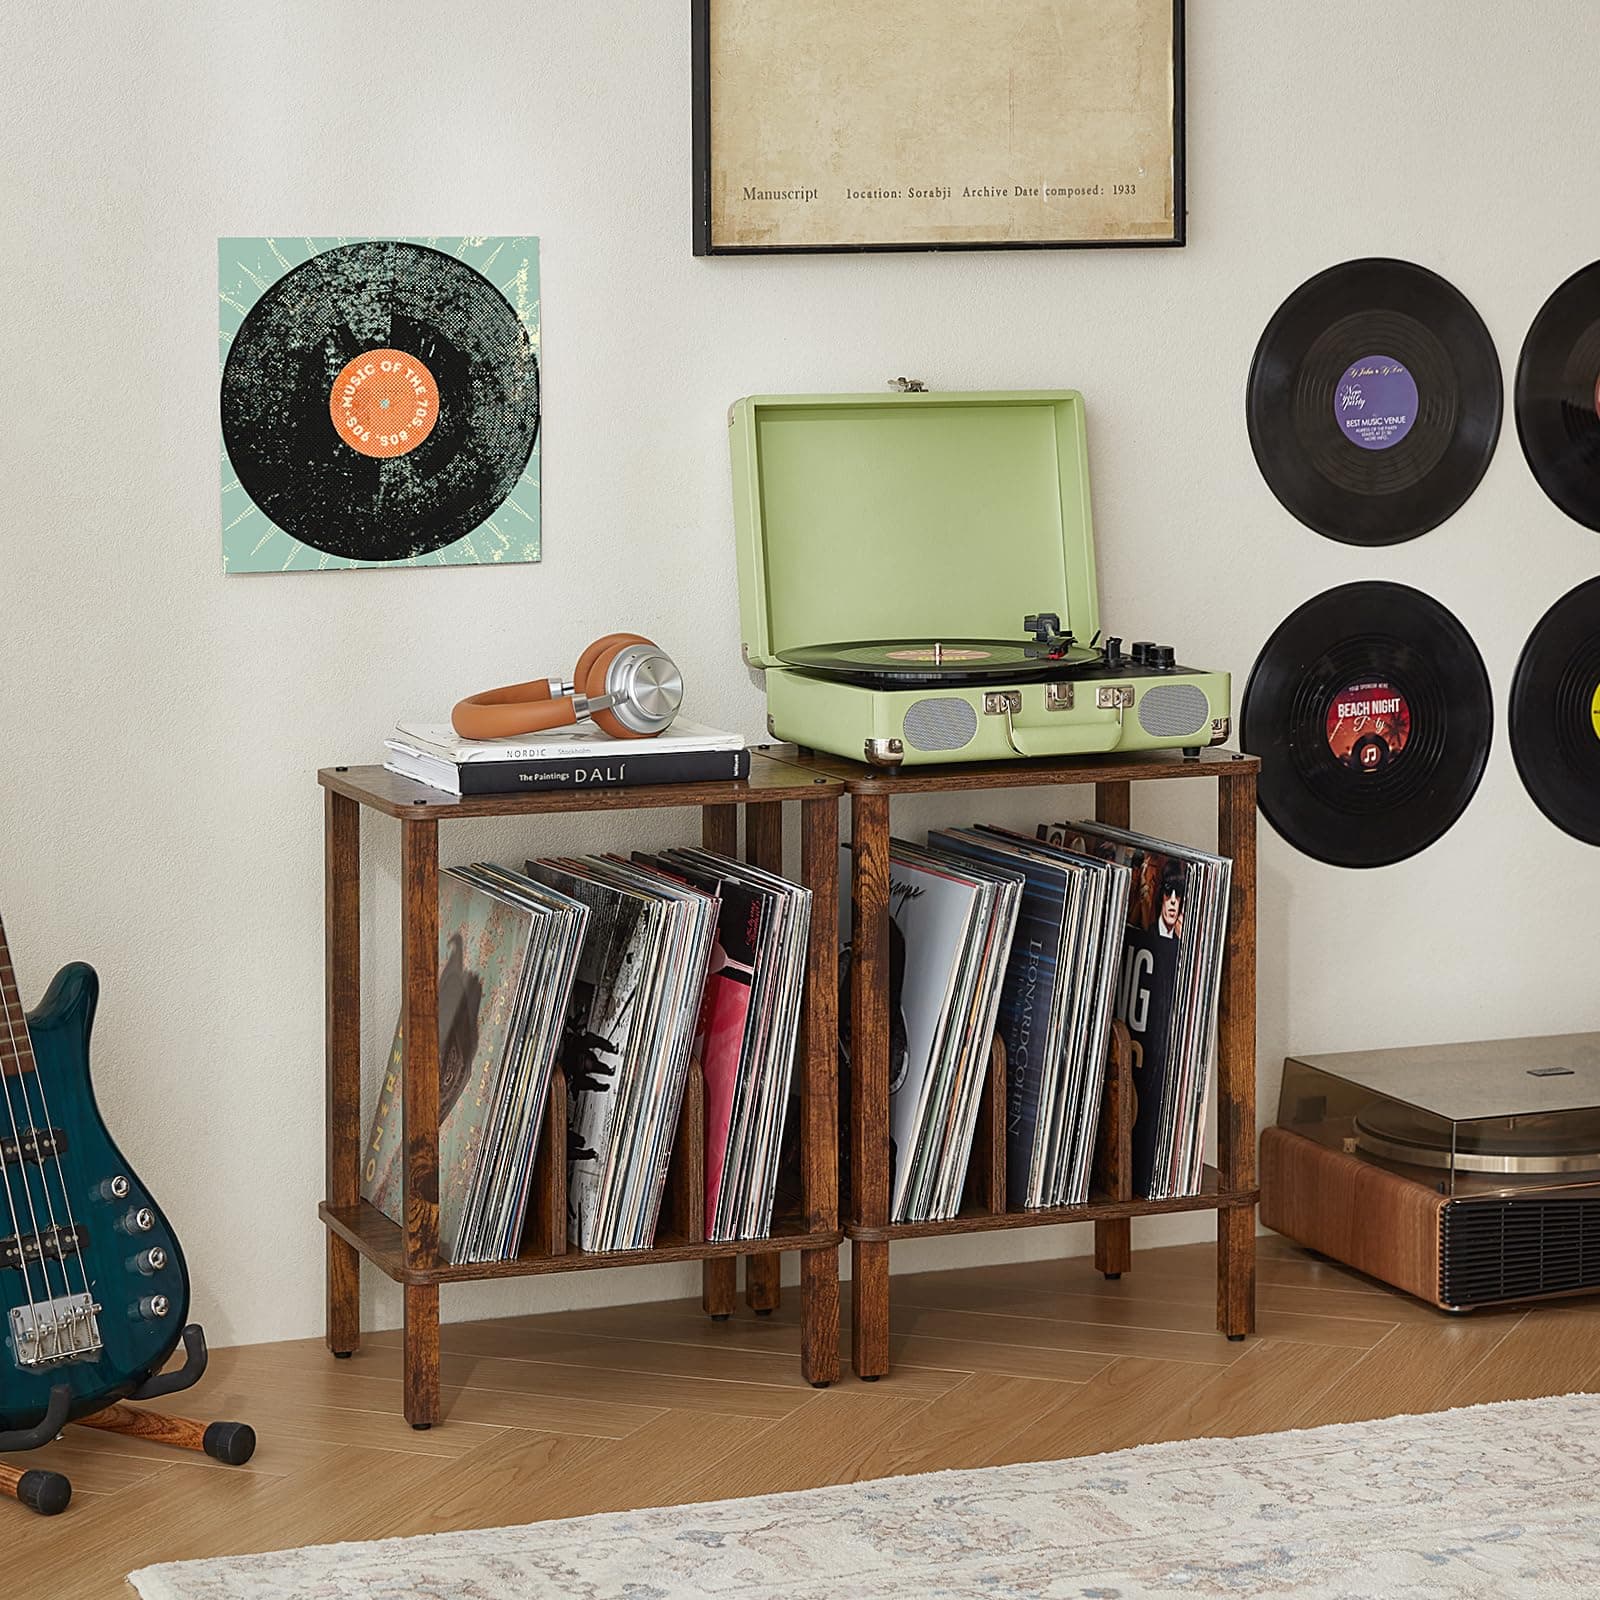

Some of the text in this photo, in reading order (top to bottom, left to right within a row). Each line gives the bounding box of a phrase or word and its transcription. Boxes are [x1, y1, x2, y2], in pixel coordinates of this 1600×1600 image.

[743, 184, 1136, 202] Manuscript location: Sorabji Archive Date composed: 1933
[342, 363, 376, 408] MUSIC
[380, 360, 402, 373] OF
[405, 368, 427, 396] THE
[1346, 416, 1406, 428] BEST MUSIC VENUE
[1338, 698, 1401, 718] BEACH NIGHT
[506, 748, 547, 758] NORDIC
[519, 763, 626, 783] The Paintings DALÍ
